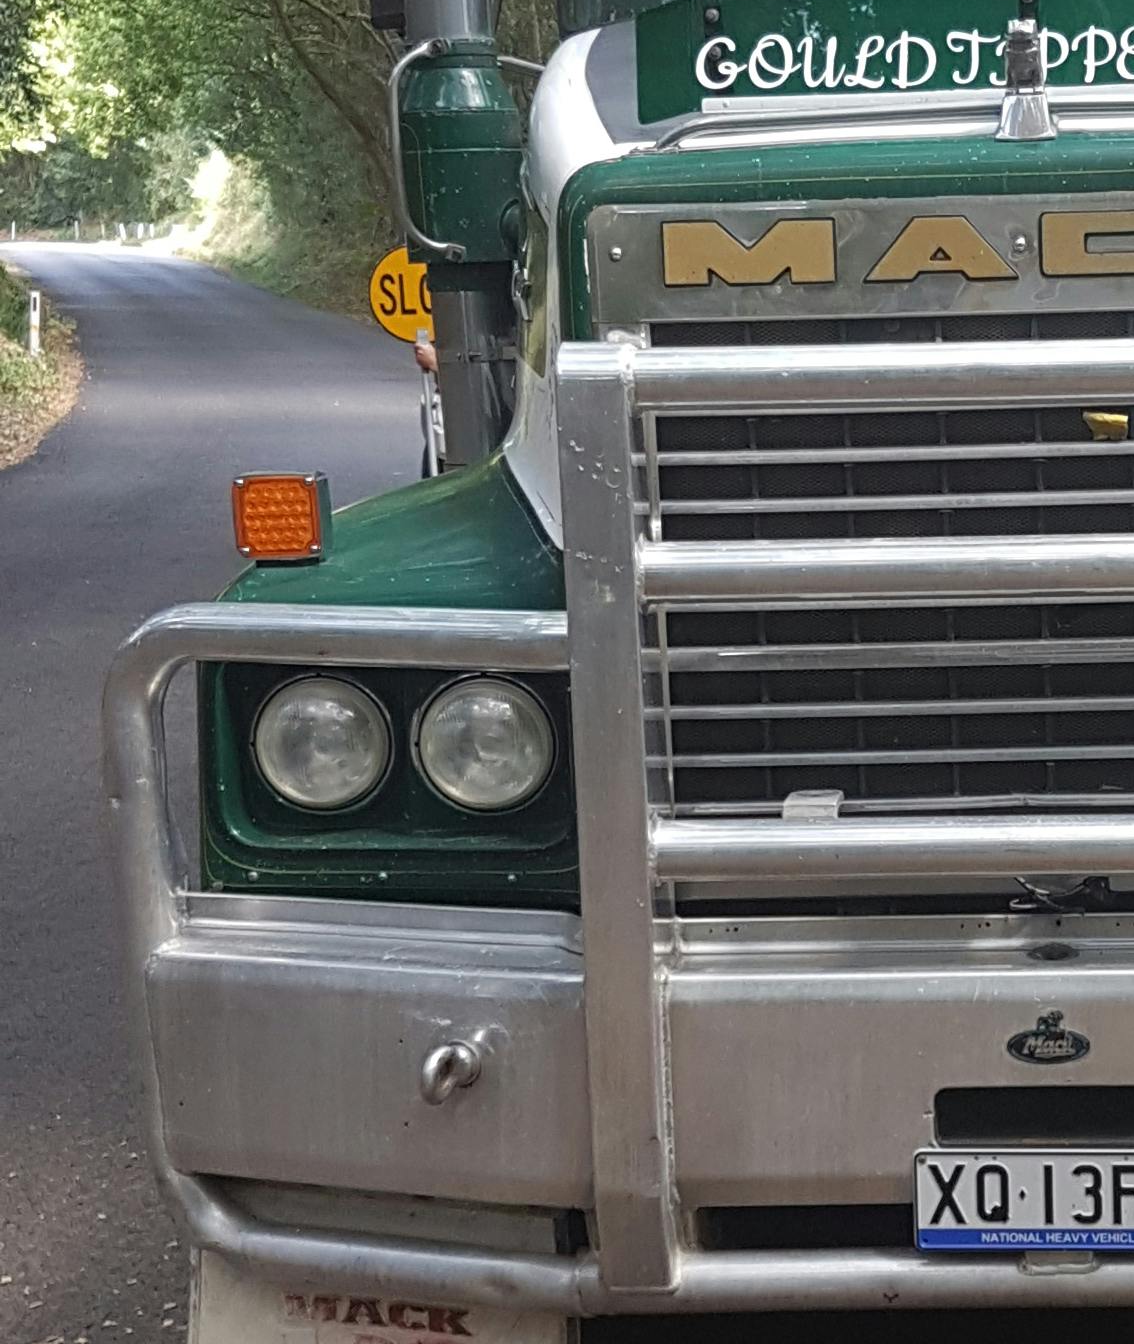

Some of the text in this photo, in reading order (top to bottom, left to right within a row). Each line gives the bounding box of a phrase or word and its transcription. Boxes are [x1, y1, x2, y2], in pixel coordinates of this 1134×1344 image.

[695, 29, 937, 89] GOULD
[981, 1232, 1043, 1244] NATIONAL
[1046, 1232, 1089, 1244] HEAVY
[285, 1293, 473, 1337] MACK
